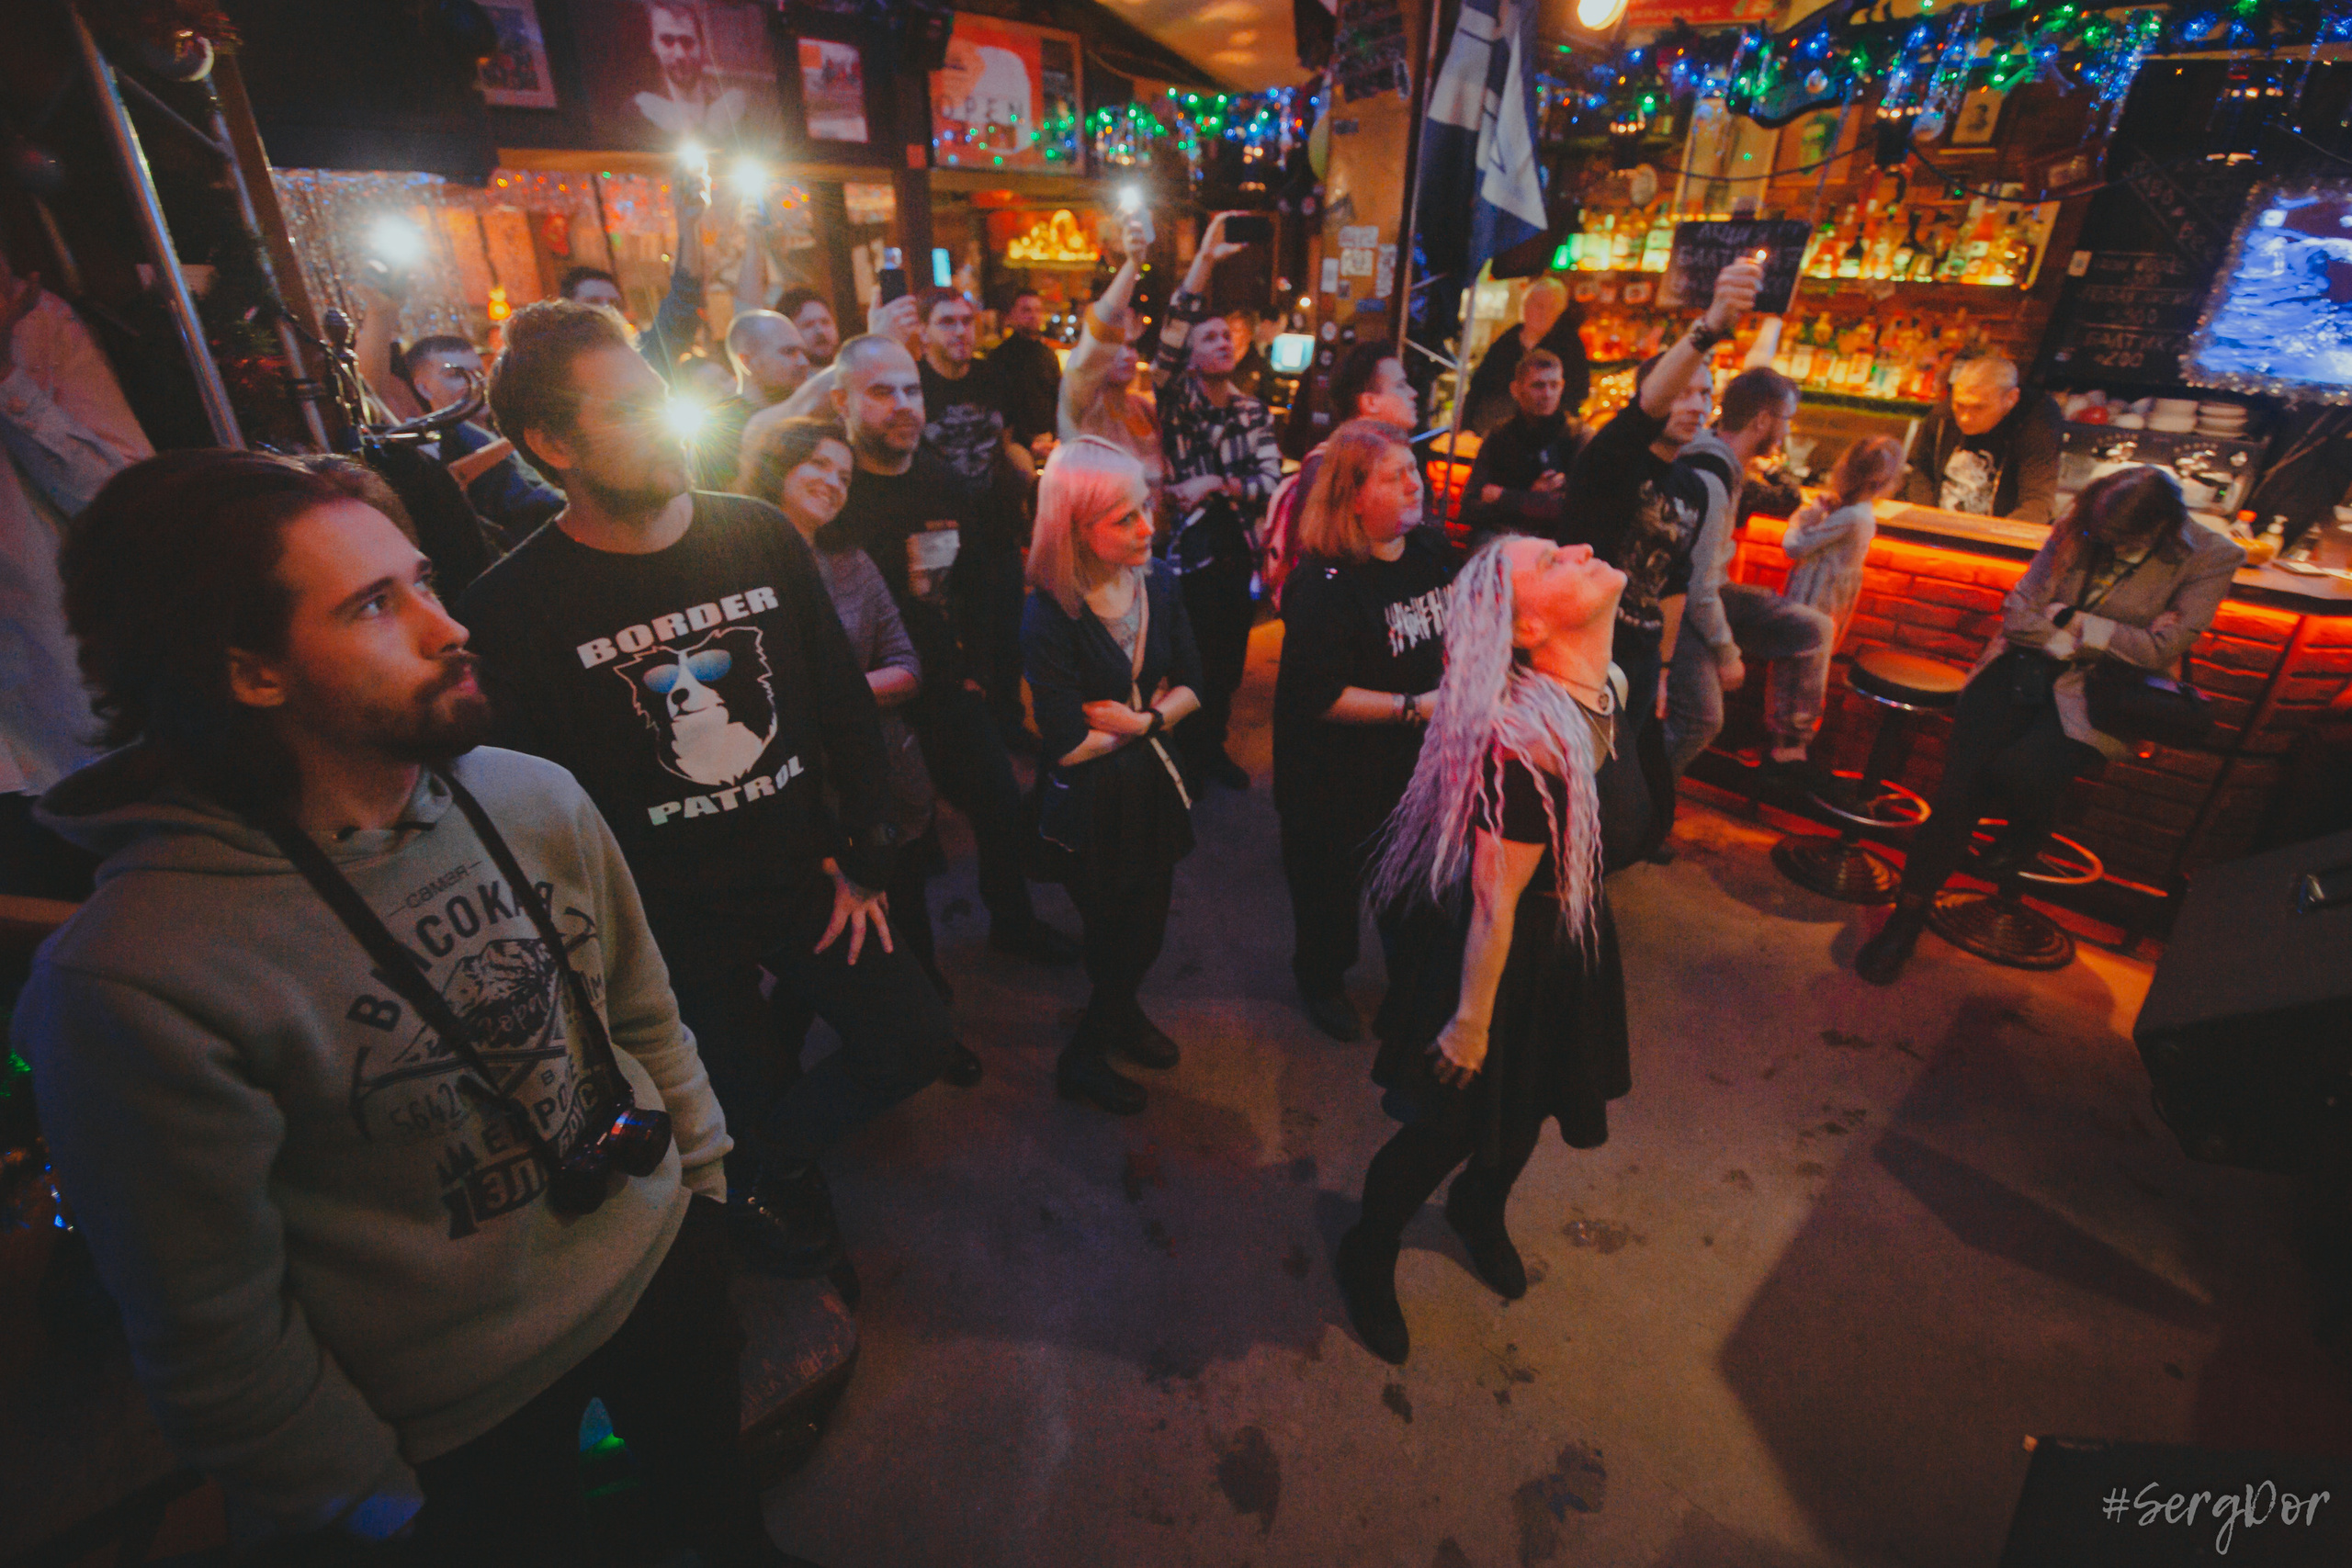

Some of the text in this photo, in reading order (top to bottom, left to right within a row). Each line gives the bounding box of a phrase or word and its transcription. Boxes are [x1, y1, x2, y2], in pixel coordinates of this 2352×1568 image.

[939, 95, 1024, 120] OPEN
[576, 585, 780, 670] BORDER
[648, 755, 806, 827] PATROL
[346, 880, 555, 1032] ВСОКЯ
[389, 1082, 460, 1134] 5642
